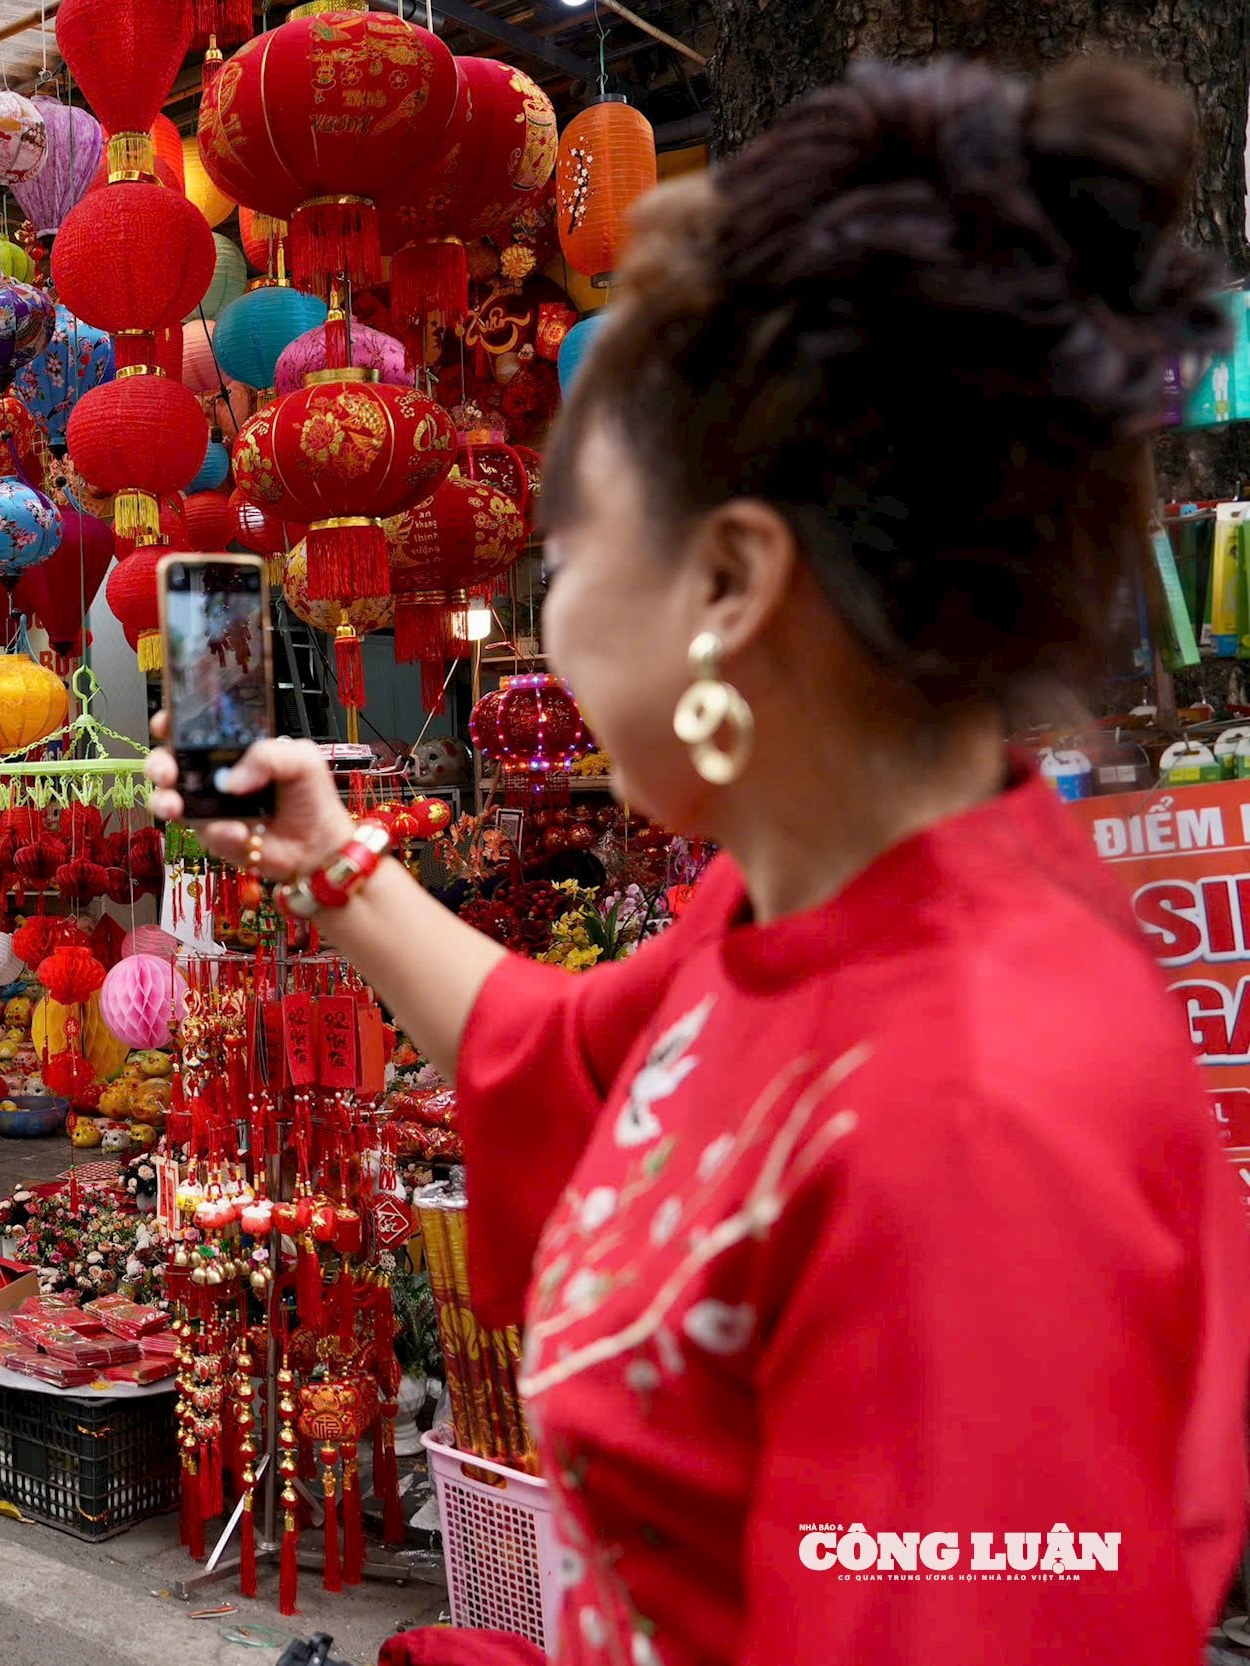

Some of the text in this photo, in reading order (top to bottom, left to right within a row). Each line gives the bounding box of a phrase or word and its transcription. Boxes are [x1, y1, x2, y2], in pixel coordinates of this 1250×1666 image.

[418, 510, 432, 519] an
[414, 520, 438, 530] khang
[1093, 795, 1226, 858] ĐIỂM
[313, 1415, 342, 1440] 福
